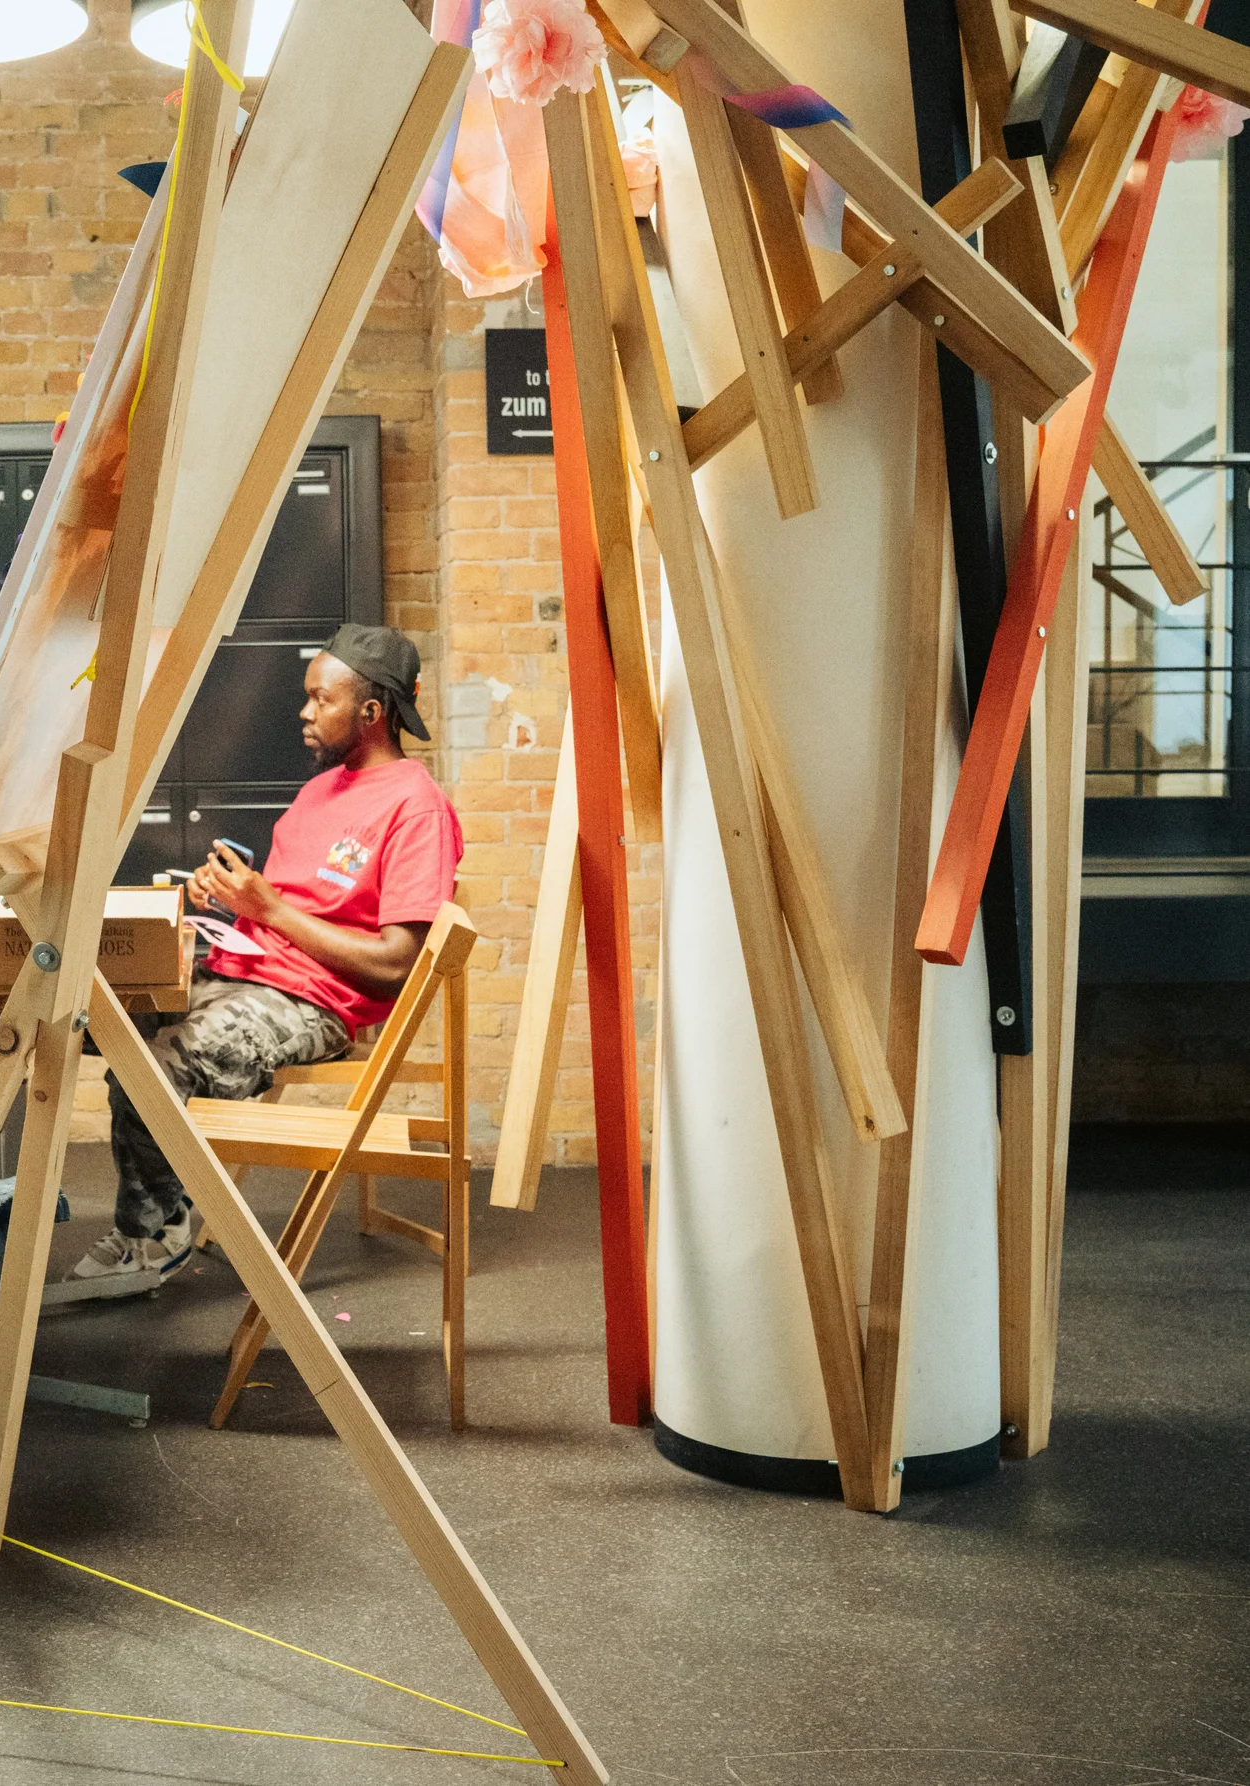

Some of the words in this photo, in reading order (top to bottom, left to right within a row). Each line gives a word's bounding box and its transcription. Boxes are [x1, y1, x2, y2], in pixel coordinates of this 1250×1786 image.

[525, 369, 540, 386] to
[501, 396, 547, 417] zum
[5, 927, 23, 937] The
[101, 927, 134, 938] alking
